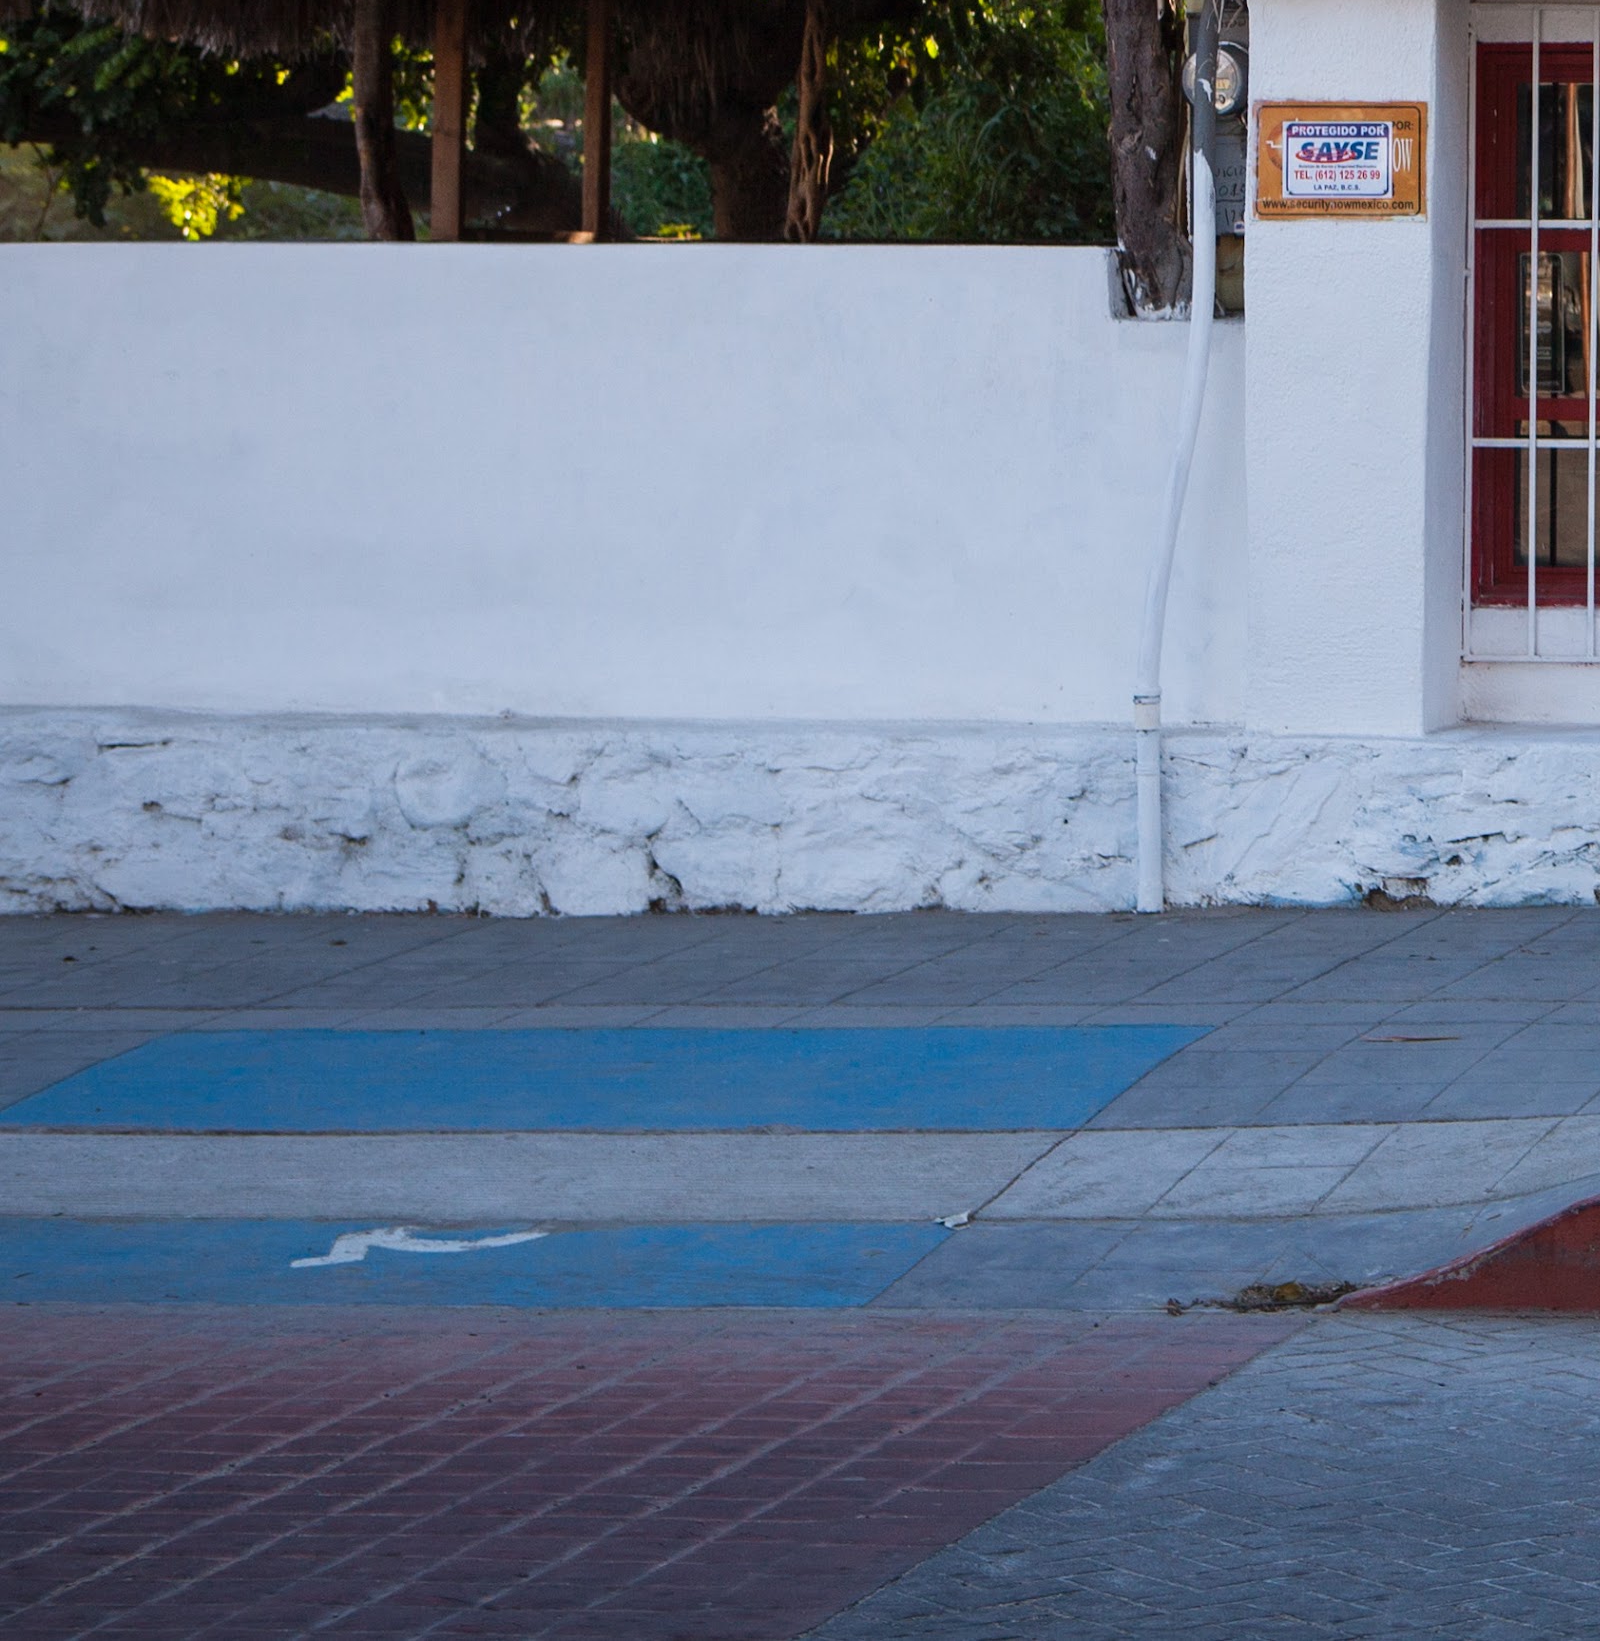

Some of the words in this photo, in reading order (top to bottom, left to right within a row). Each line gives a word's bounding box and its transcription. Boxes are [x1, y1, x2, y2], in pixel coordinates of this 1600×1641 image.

[1292, 125, 1357, 137] PROTEGIDO
[1360, 125, 1386, 137] POR
[1299, 141, 1380, 162] SAYSE
[1393, 137, 1414, 173] OW
[1294, 170, 1313, 181] TEL.
[1315, 170, 1337, 183] (612)
[1340, 170, 1355, 181] 125
[1357, 170, 1368, 181] 26
[1370, 170, 1381, 181] 99
